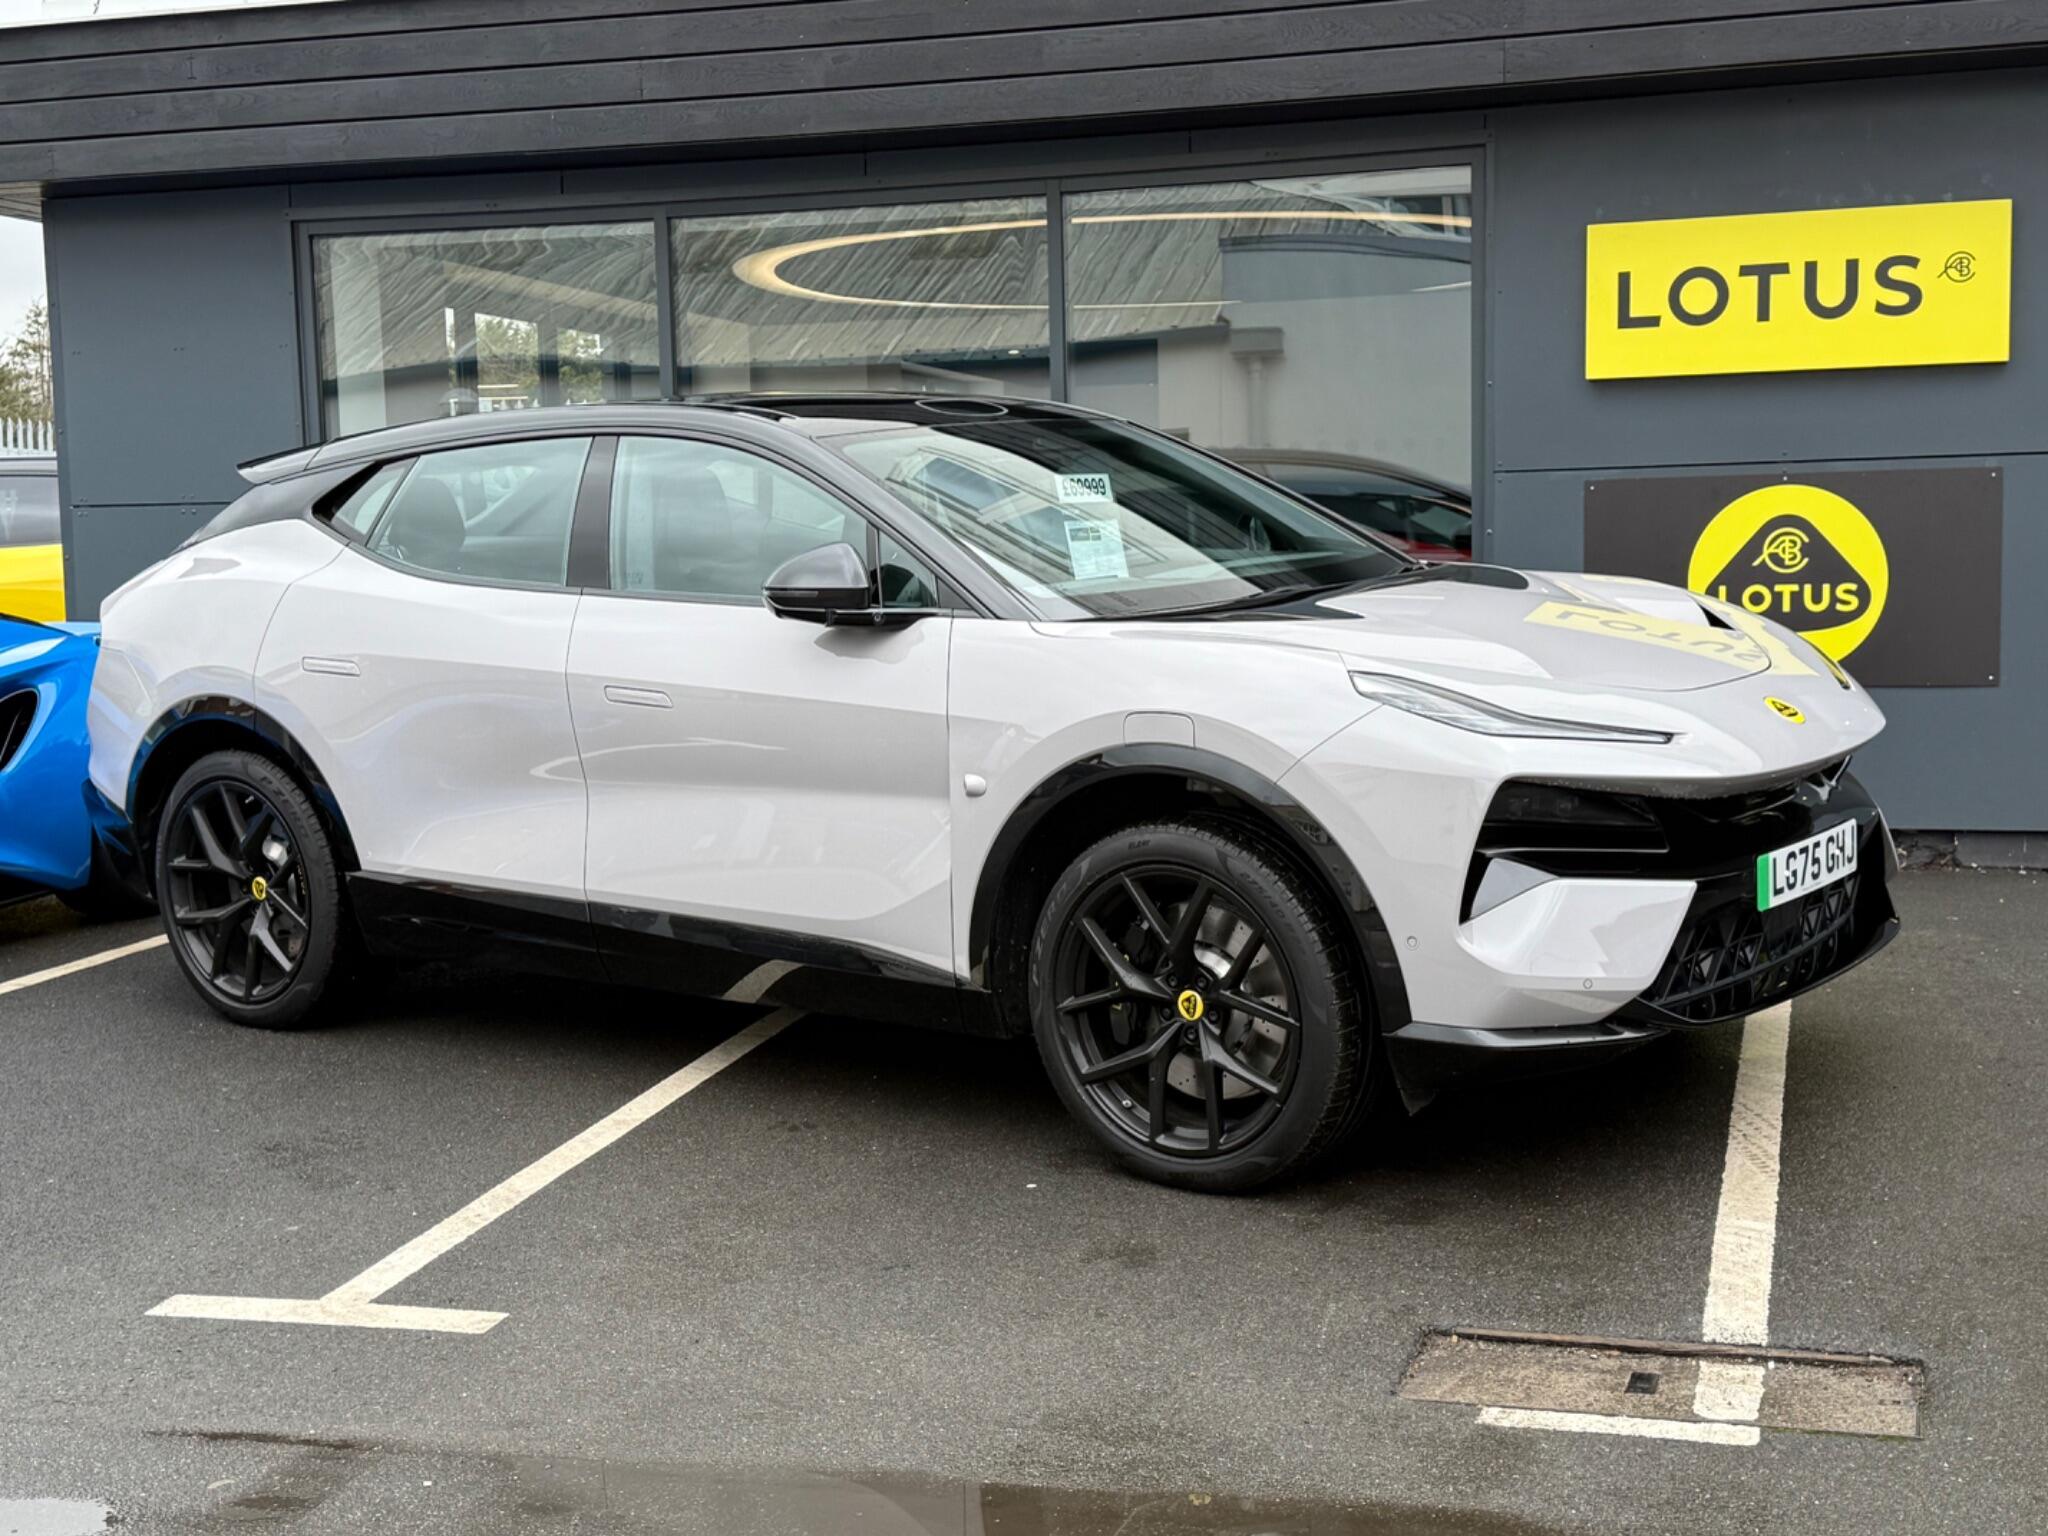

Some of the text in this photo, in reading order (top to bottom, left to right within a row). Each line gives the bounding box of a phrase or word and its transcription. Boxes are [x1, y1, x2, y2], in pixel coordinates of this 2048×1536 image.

[1617, 254, 1922, 329] LOTUS
[1772, 824, 1855, 898] LG75 GHJ
